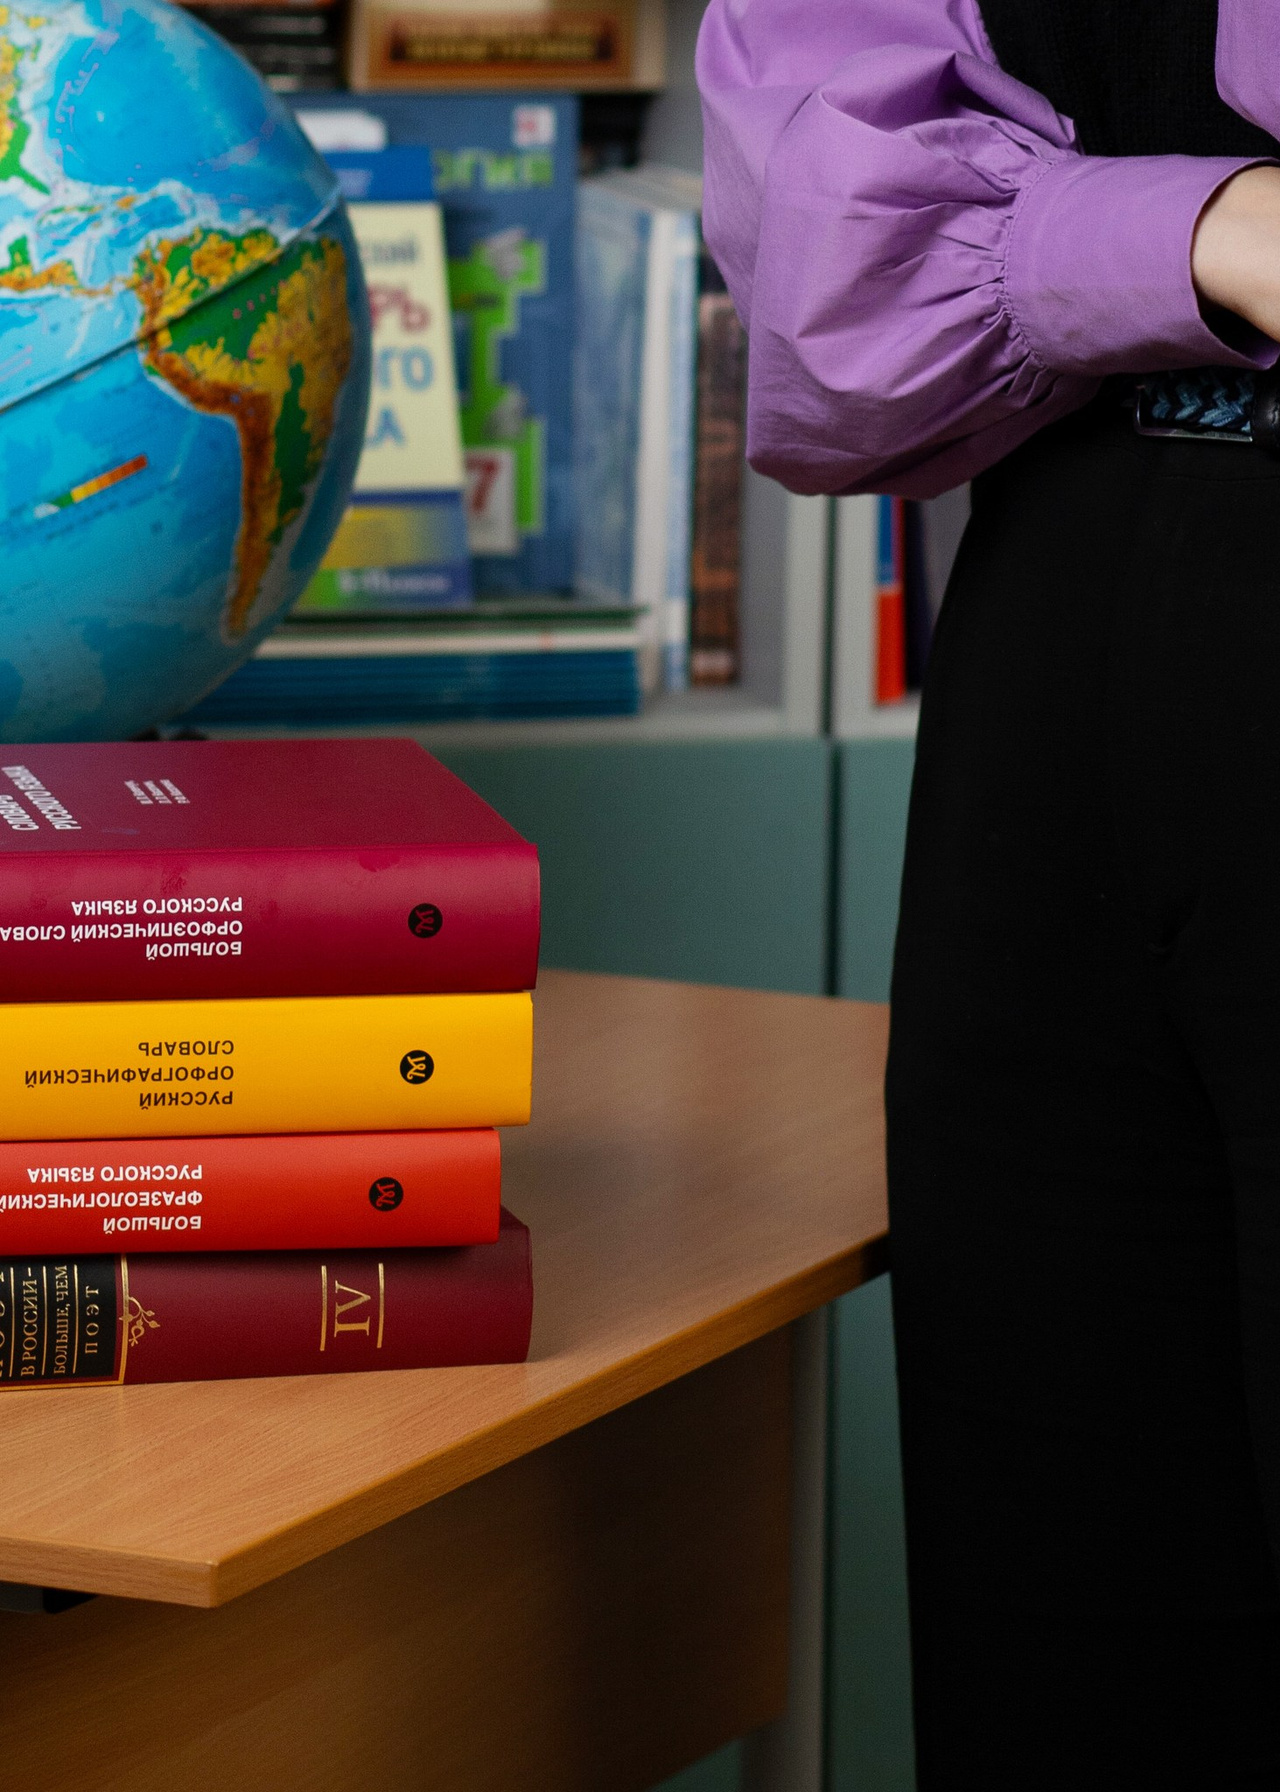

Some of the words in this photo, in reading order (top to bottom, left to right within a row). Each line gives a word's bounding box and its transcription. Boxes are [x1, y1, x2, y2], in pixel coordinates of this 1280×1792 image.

[466, 456, 499, 514] 7
[24, 790, 82, 830] РУССКОГО
[71, 899, 137, 916] ЯЗЫКА
[142, 896, 243, 914] РУССКОГО
[71, 920, 243, 943] ОРФОЭПИЧЕСКИЙ
[145, 941, 242, 961] БОЛЬШОЙ
[138, 1040, 234, 1057] СЛОВАРЬ
[25, 1065, 234, 1088] ОРФОГРАФИЧЕСКИЙ
[139, 1090, 234, 1110] РУССКИЙ
[27, 1167, 95, 1183] ЯЗЫКА
[100, 1164, 203, 1182] РУССКОГО
[0, 1191, 203, 1213] ФРАЗЕОЛОГИЧЕСКИЙ
[103, 1215, 202, 1235] БОЛЬШОЙ
[54, 1264, 69, 1302] ЧЕМ
[333, 1279, 372, 1338] IV
[84, 1284, 100, 1355] ПОЭТ
[53, 1302, 71, 1375] БОЛЬШЕ,
[20, 1364, 36, 1377] В
